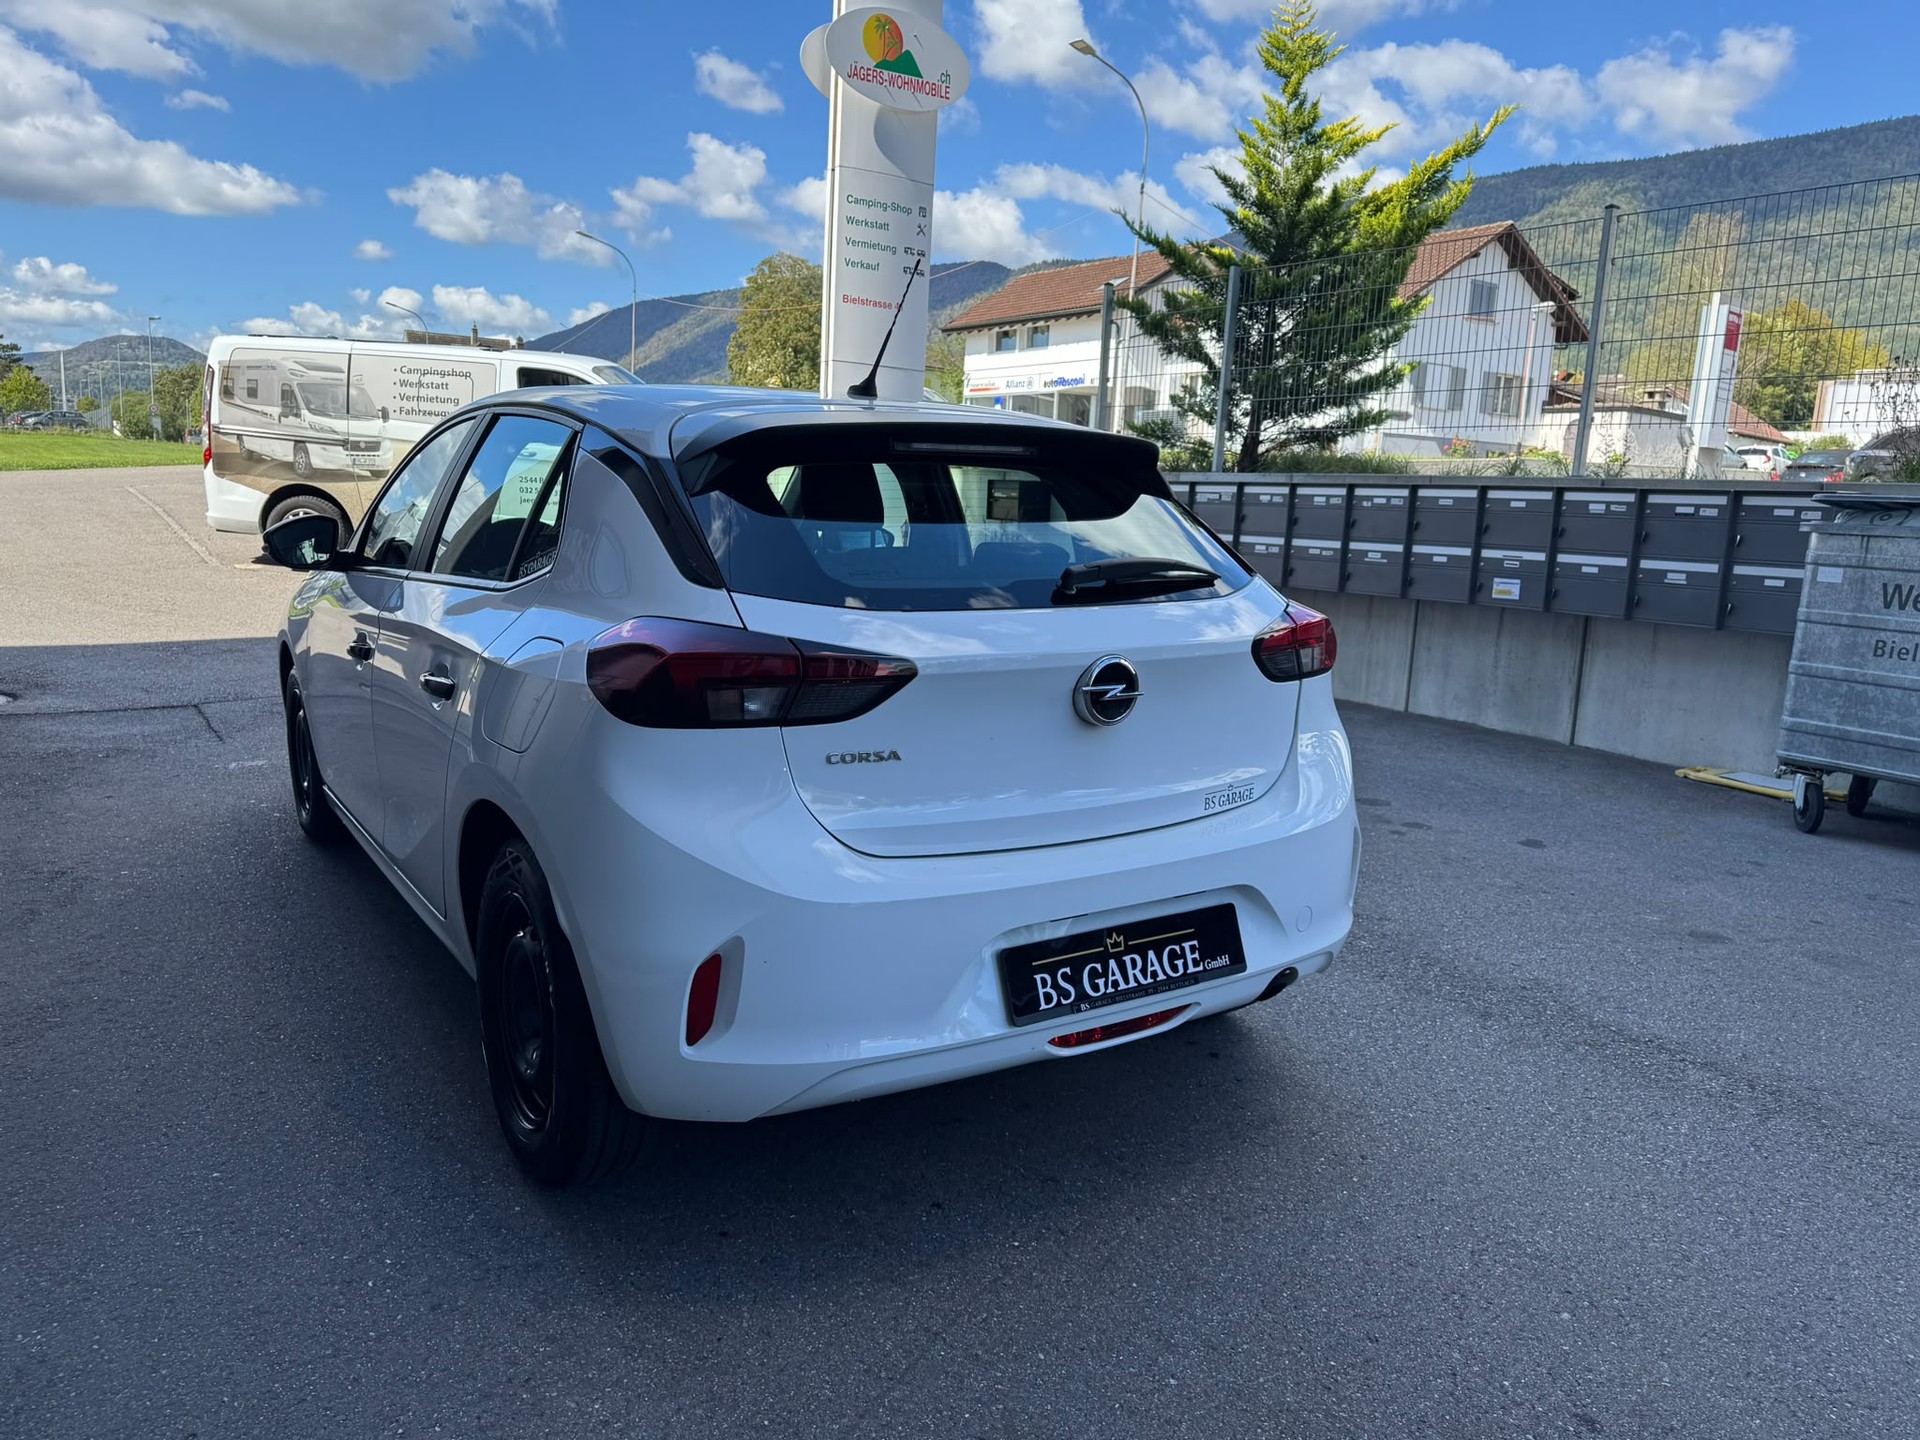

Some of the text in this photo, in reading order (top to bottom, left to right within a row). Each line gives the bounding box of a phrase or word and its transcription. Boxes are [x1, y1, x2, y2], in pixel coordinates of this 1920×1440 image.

[846, 60, 950, 100] JÄGERS-WOHNMOBILE
[937, 69, 950, 84] .ch
[846, 194, 912, 216] Camping-Shop
[846, 215, 889, 231] Werkstatt
[845, 236, 897, 255] Vermietung
[844, 257, 880, 271] Verkauf
[842, 294, 892, 309] Bielstrasse
[400, 365, 471, 379] Campingshop
[399, 379, 449, 390] Werkstatt
[399, 392, 460, 407] Vermietung
[519, 476, 538, 484] 2544
[825, 749, 902, 765] CORSA
[1204, 787, 1255, 811] BS GARAGE
[1033, 940, 1230, 1011] BS GARAGE GmbH
